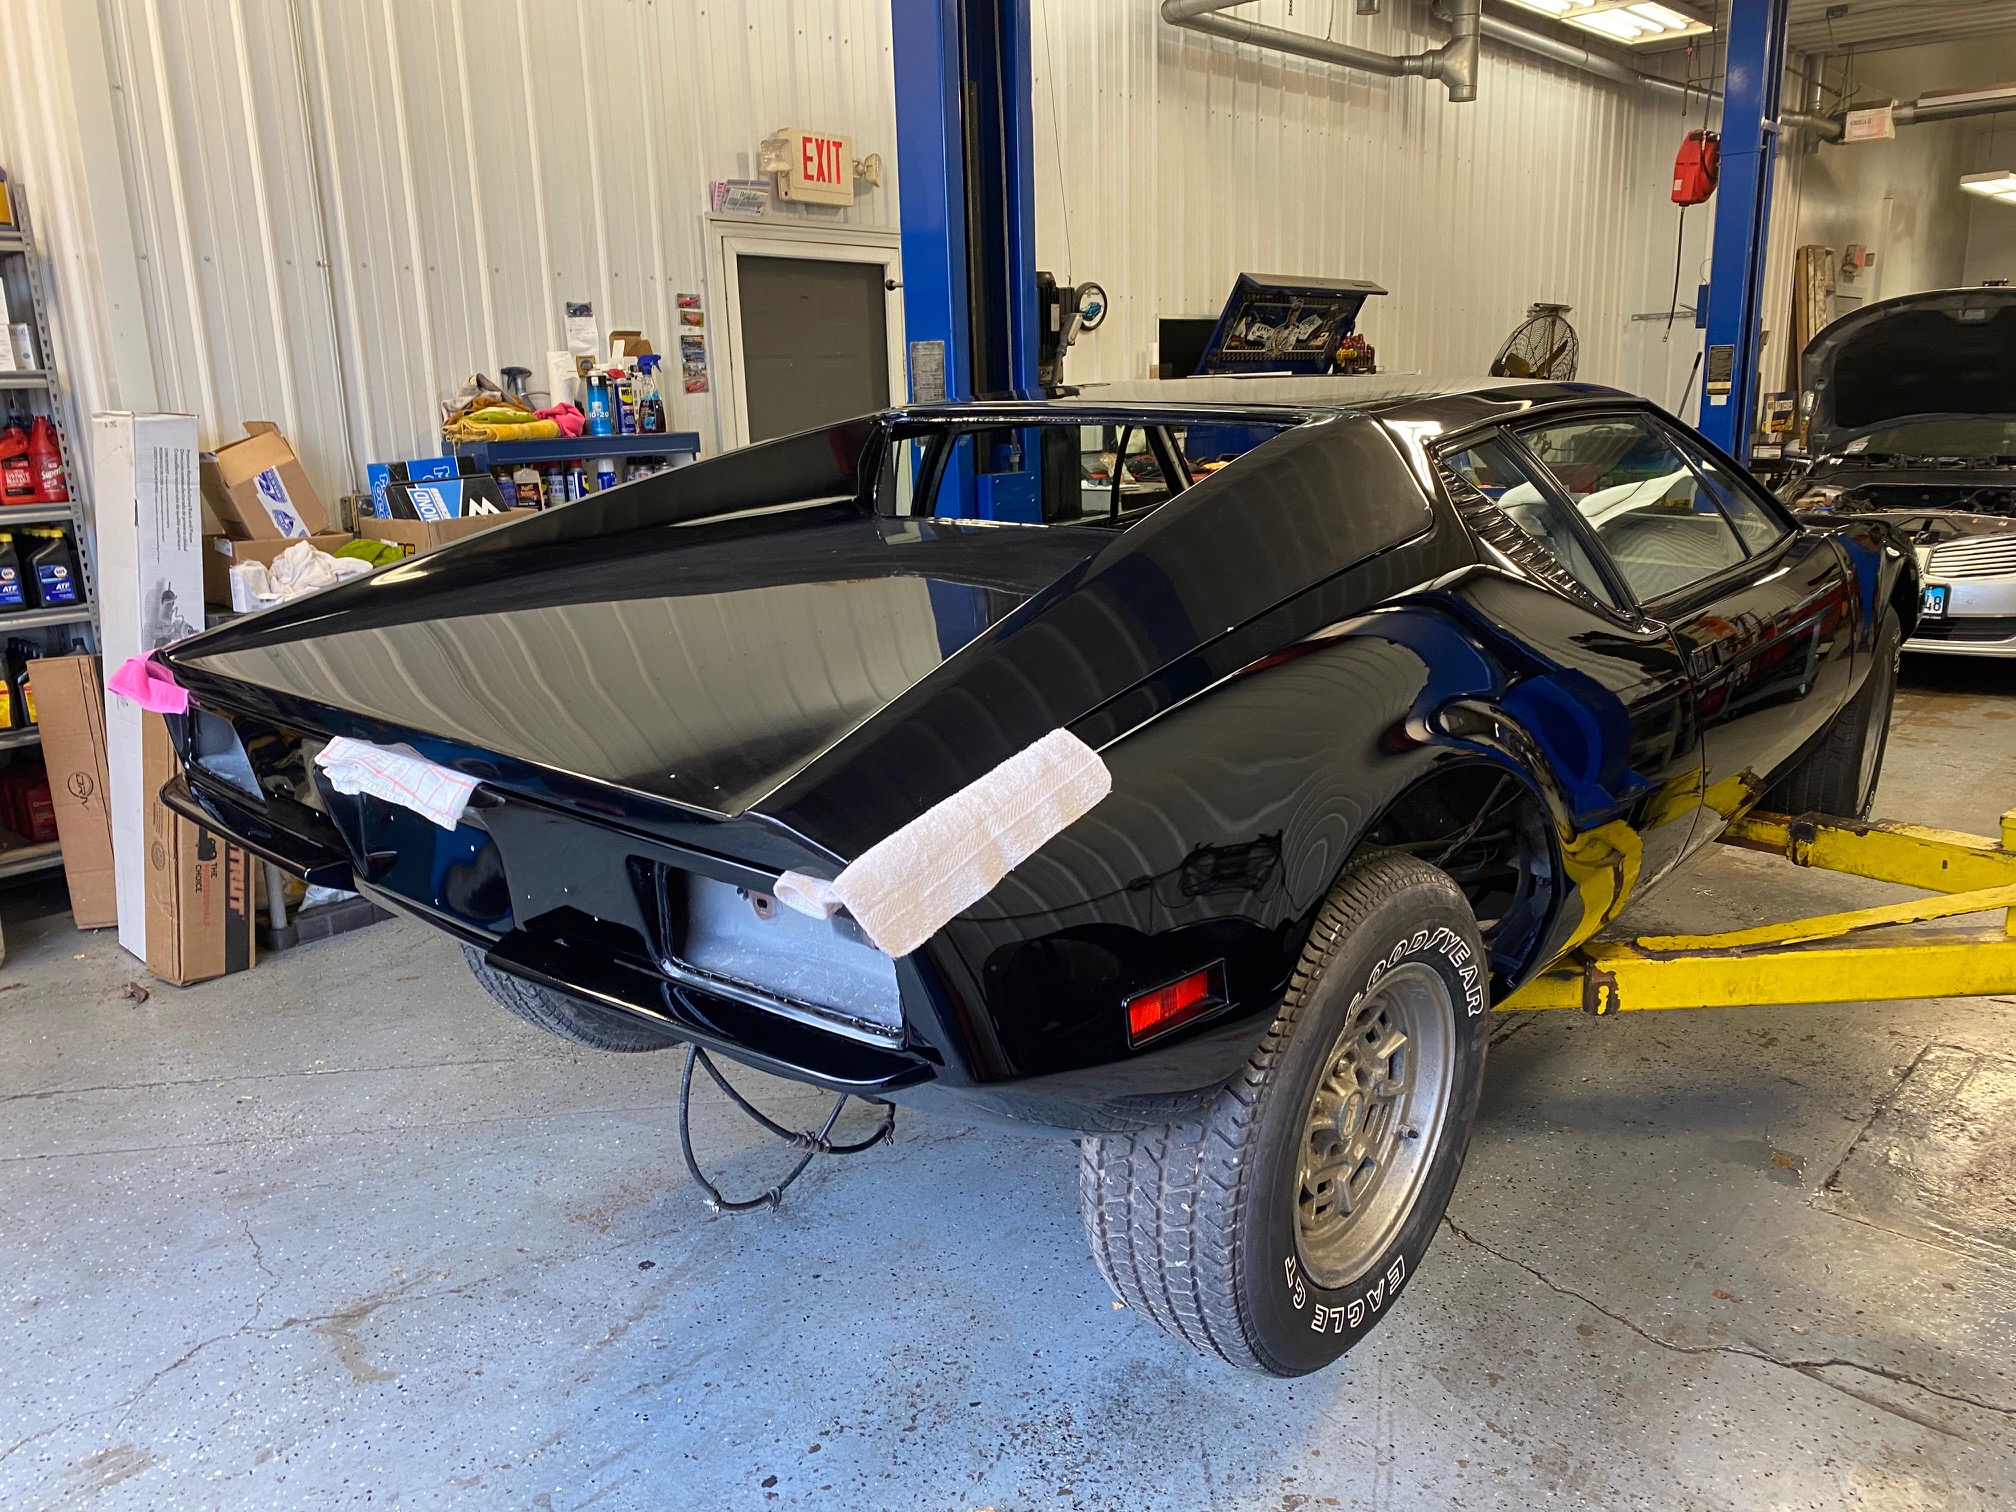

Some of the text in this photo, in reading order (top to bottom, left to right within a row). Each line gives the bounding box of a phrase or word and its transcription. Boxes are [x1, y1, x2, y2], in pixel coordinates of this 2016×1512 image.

[802, 136, 842, 184] EXIT
[2, 585, 18, 593] ATF
[56, 582, 70, 590] ATF
[1284, 1254, 1406, 1334] EAGLE GT
